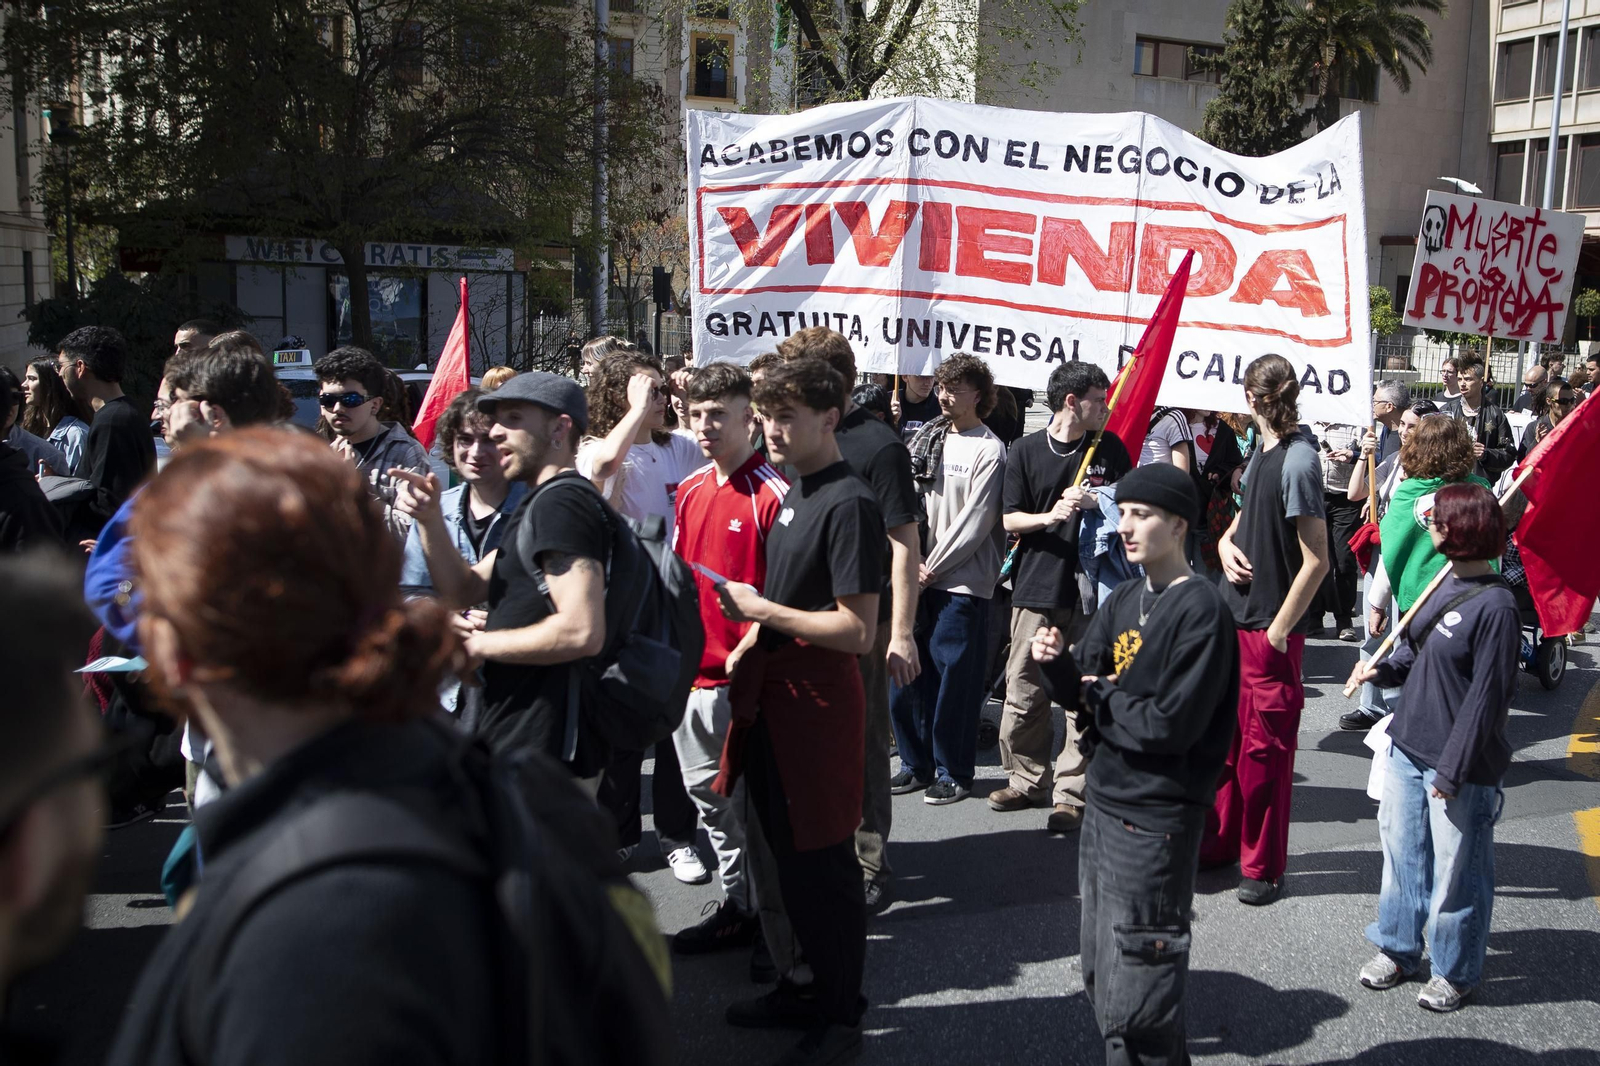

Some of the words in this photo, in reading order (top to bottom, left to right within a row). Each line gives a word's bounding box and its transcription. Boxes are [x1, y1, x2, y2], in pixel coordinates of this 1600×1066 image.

[700, 129, 894, 168] ACABEMOS
[908, 128, 989, 163] CON
[1003, 139, 1049, 171] EL
[1063, 144, 1245, 197] NEGOCIO
[1258, 180, 1306, 204] DE
[1316, 163, 1341, 200] LA
[246, 236, 313, 261] WIFI
[363, 243, 450, 268] RATIS
[716, 199, 1331, 317] VIVIENDA
[279, 352, 296, 363] TAXI
[705, 311, 868, 348] GRATUITA,
[1176, 350, 1351, 395] CALAD
